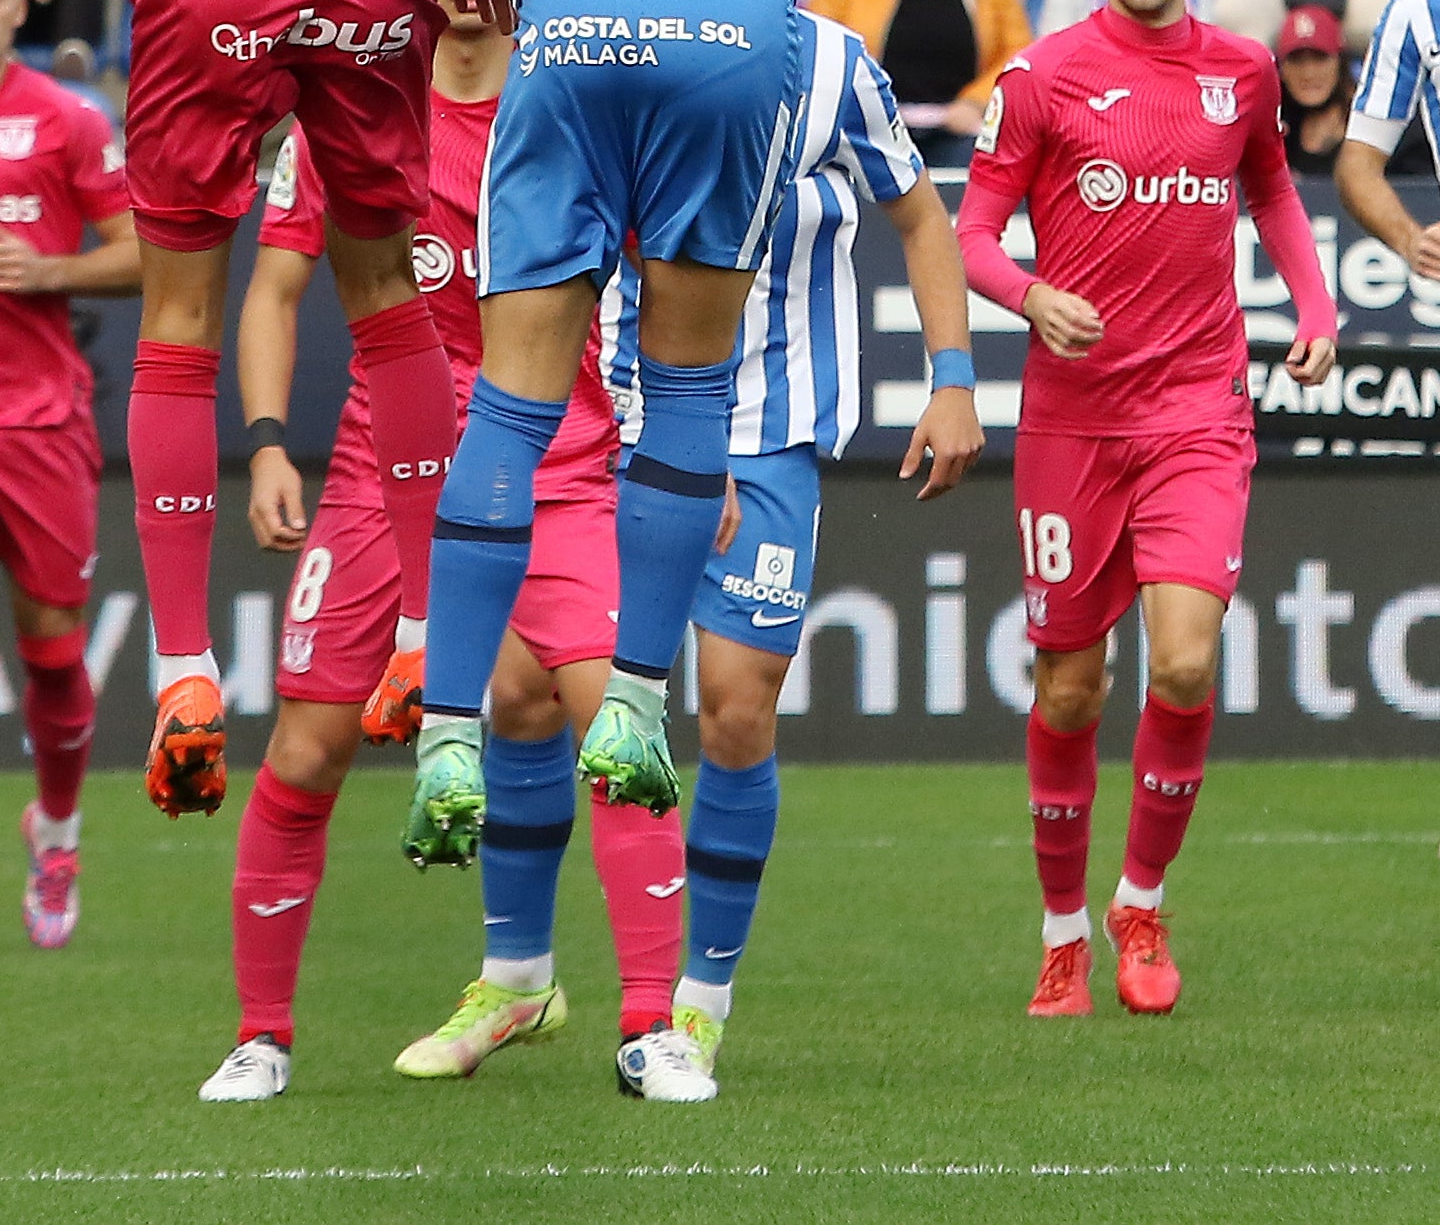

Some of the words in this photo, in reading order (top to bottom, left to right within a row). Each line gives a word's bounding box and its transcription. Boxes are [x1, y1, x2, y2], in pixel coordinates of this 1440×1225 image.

[543, 16, 628, 40] COSTA
[638, 18, 693, 41] DEL
[699, 21, 752, 50] SOL
[544, 38, 659, 67] MÁLAGA
[1134, 166, 1230, 205] urbas
[1018, 507, 1074, 585] 18
[290, 547, 333, 622] 8
